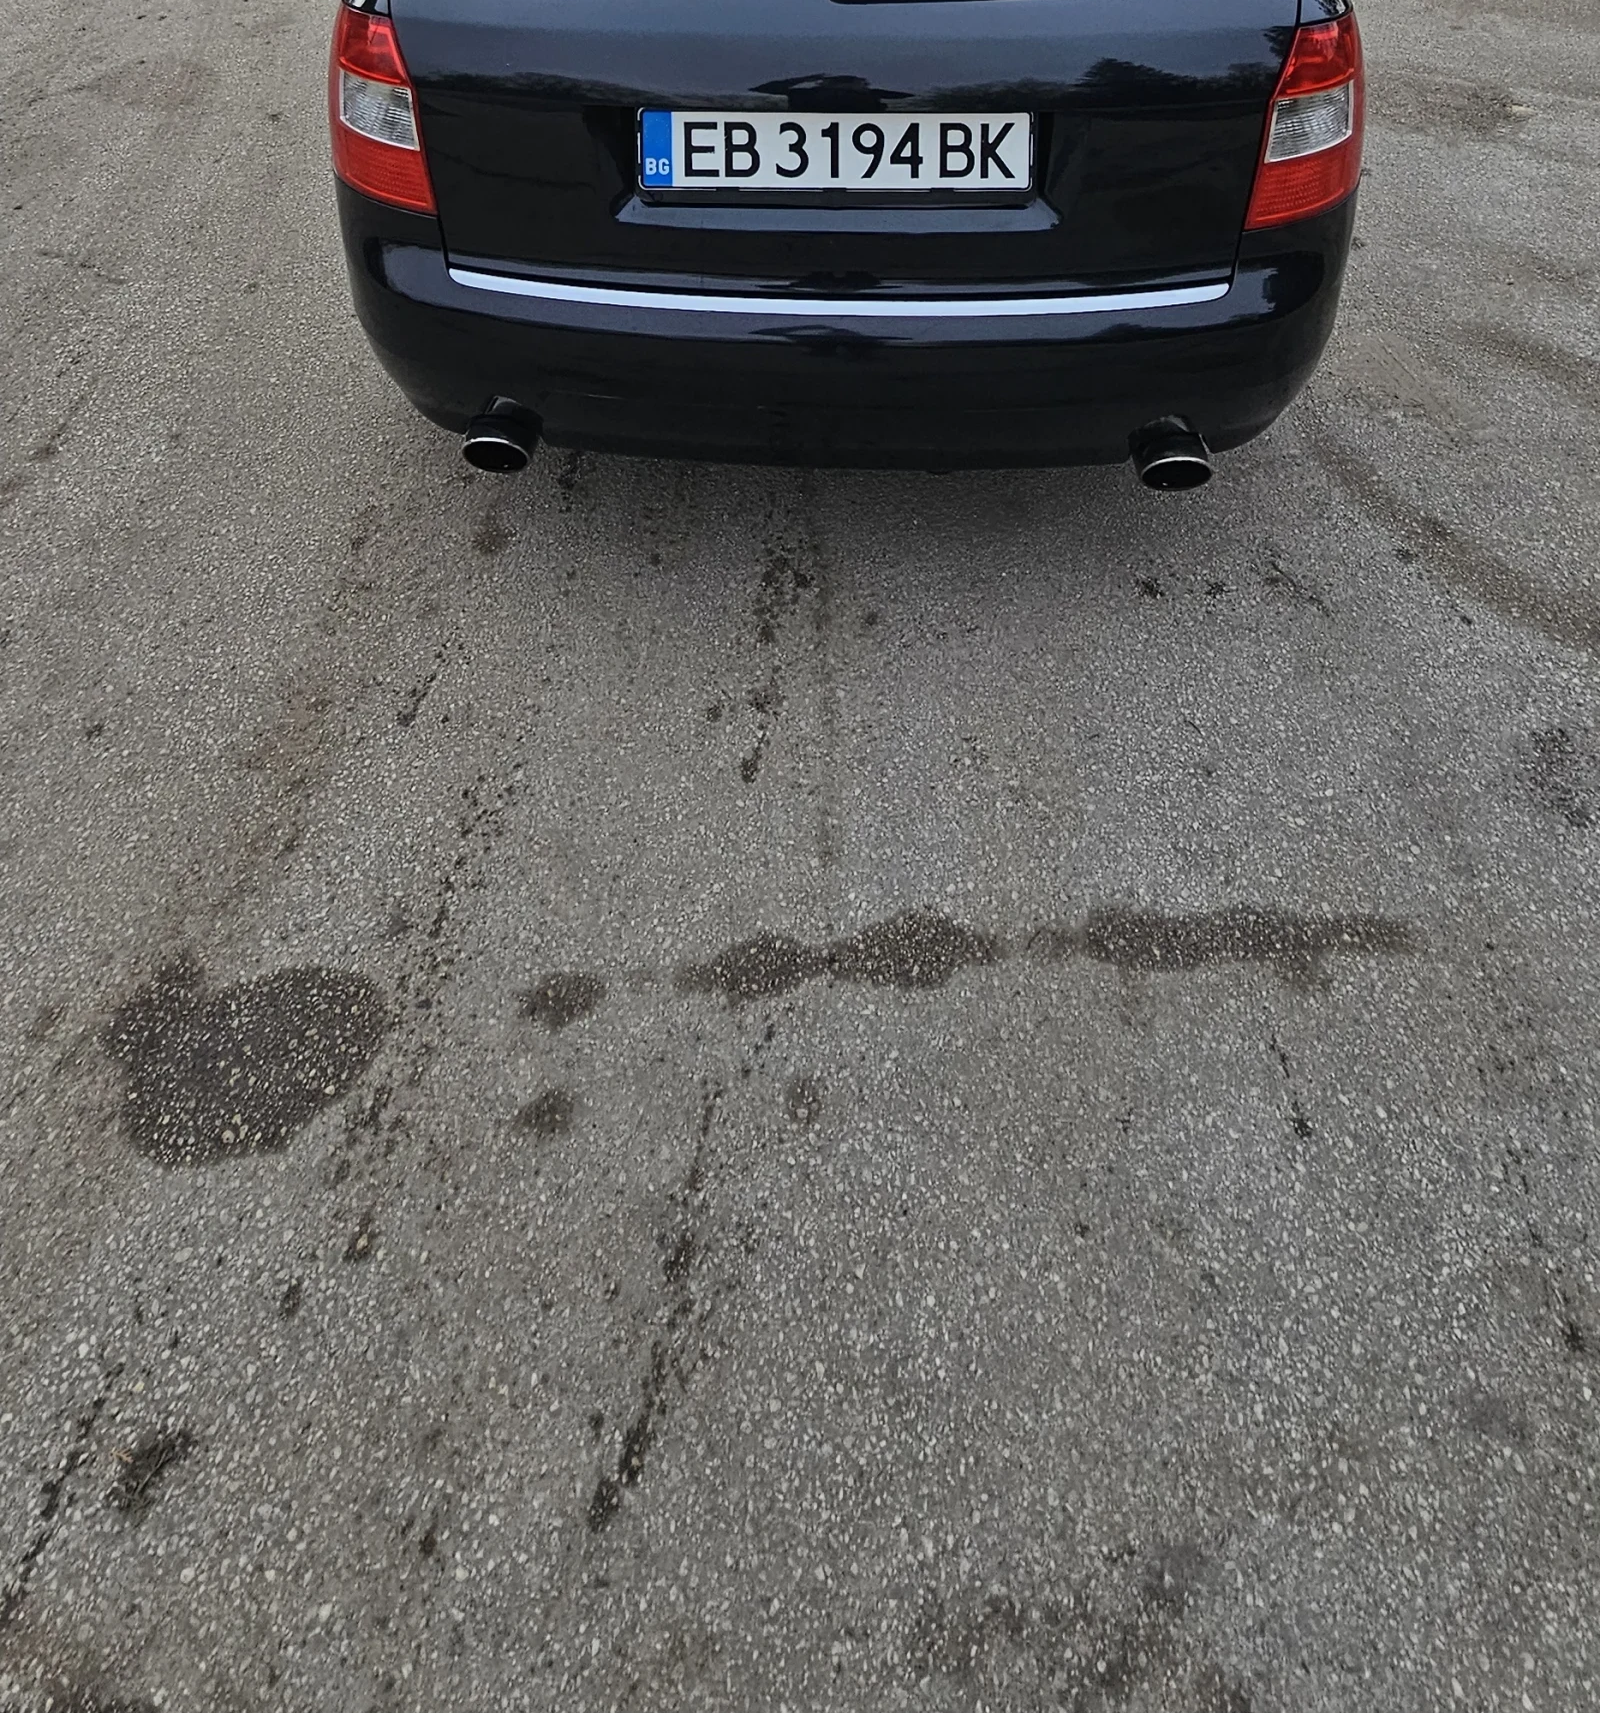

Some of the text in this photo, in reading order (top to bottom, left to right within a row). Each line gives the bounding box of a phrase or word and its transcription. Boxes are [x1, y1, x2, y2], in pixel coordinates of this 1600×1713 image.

[645, 157, 670, 175] BG
[683, 121, 1015, 179] EB 3194 BK
